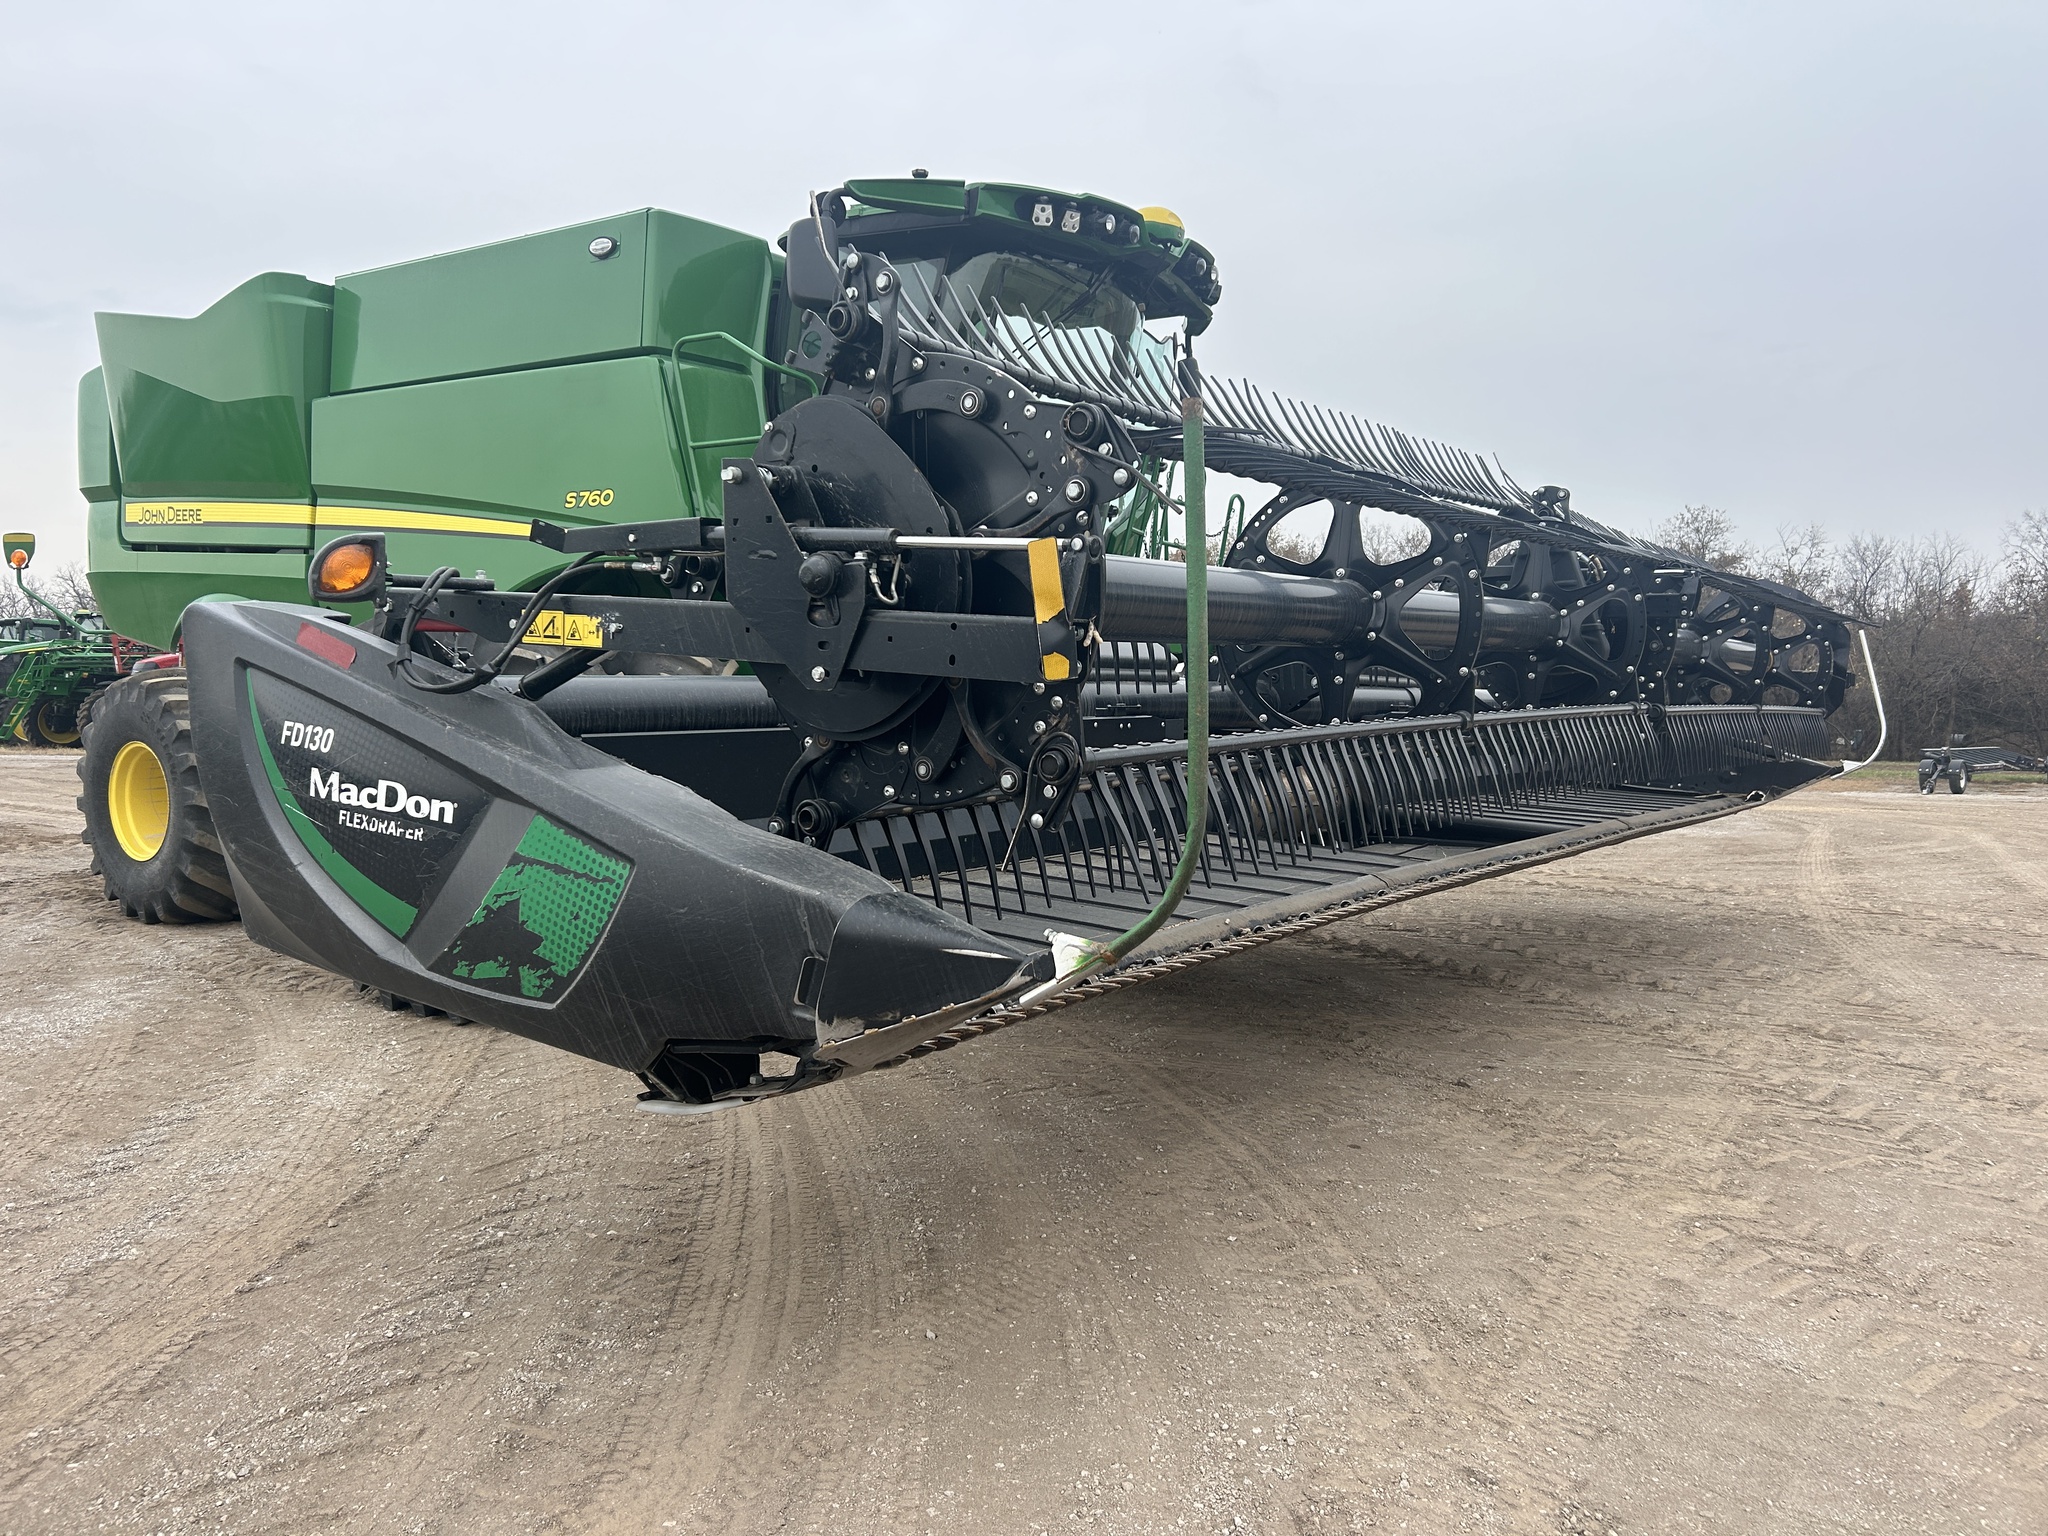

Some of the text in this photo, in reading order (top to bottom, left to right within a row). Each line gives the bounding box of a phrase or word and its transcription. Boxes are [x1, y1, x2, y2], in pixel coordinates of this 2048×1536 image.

[564, 488, 615, 509] S760
[138, 506, 203, 523] JOHN DEERE
[281, 720, 335, 753] FD130
[309, 767, 455, 824] MacDon
